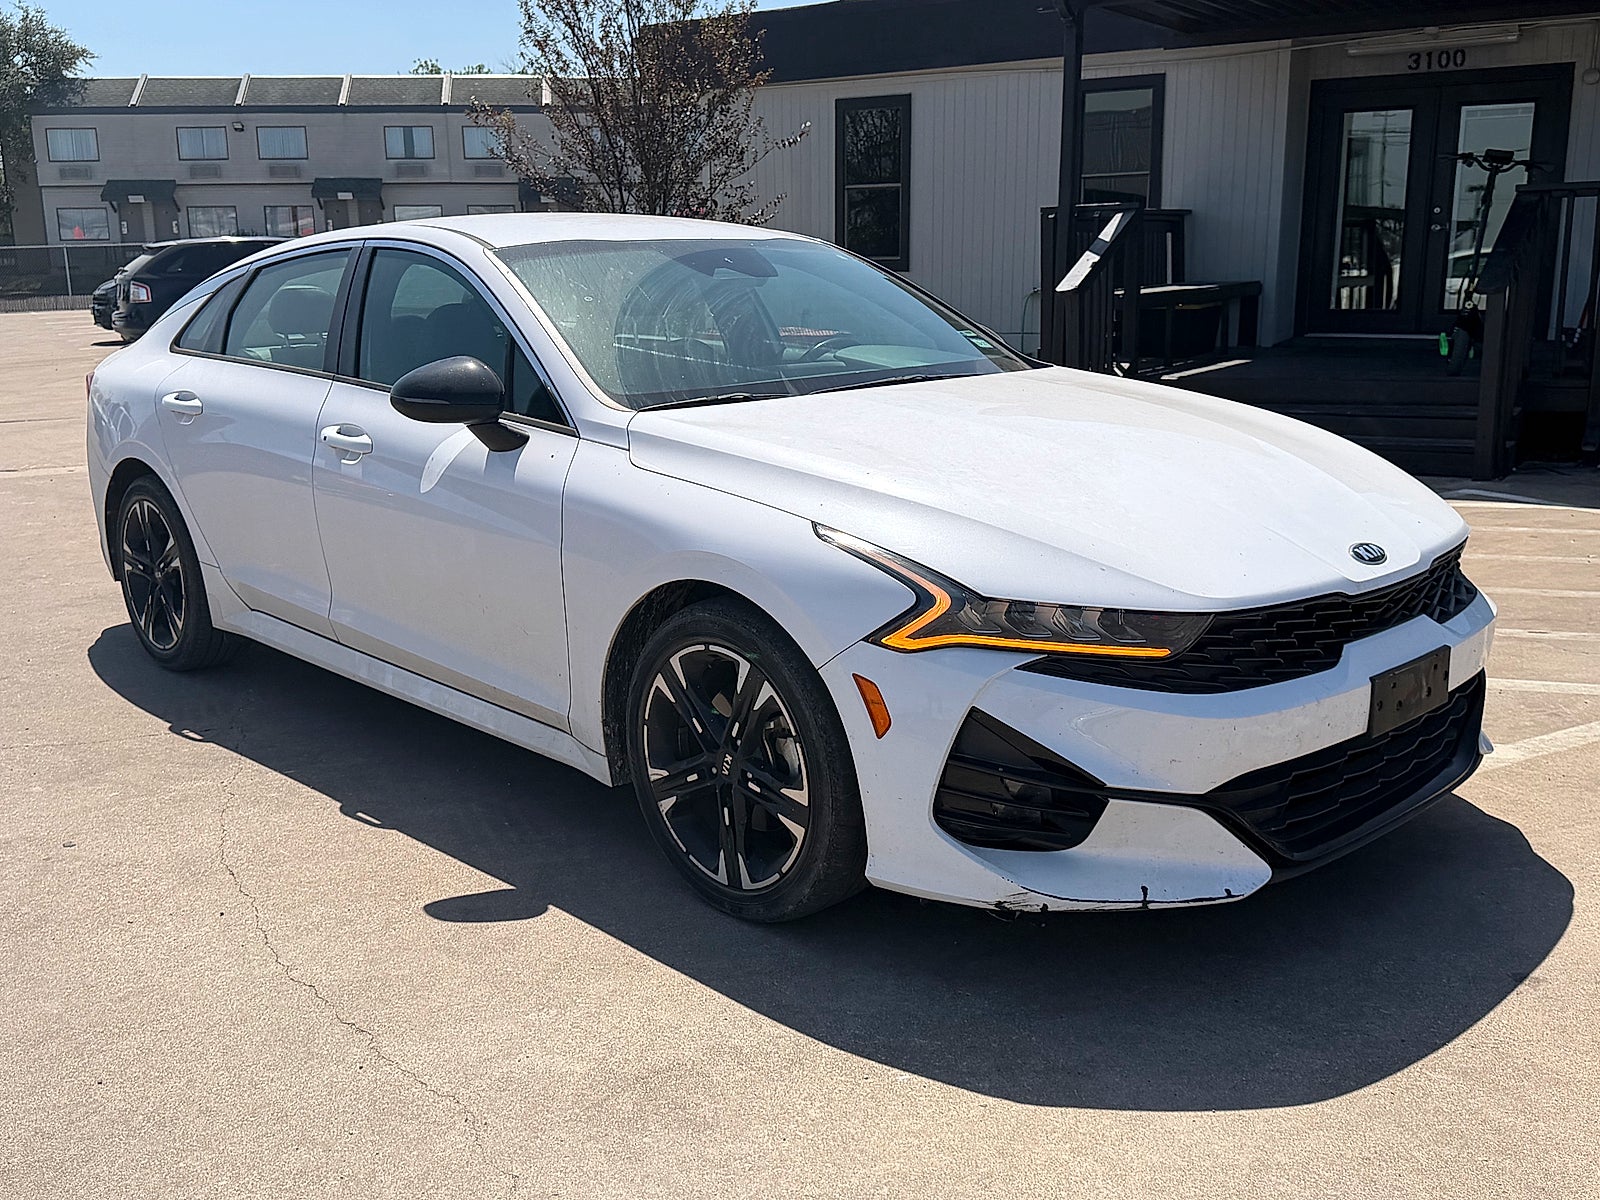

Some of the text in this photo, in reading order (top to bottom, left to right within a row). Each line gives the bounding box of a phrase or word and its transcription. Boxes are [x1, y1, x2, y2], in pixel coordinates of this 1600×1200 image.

[1407, 48, 1466, 71] 3100
[1353, 544, 1385, 561] KIA
[721, 753, 733, 776] KIA
